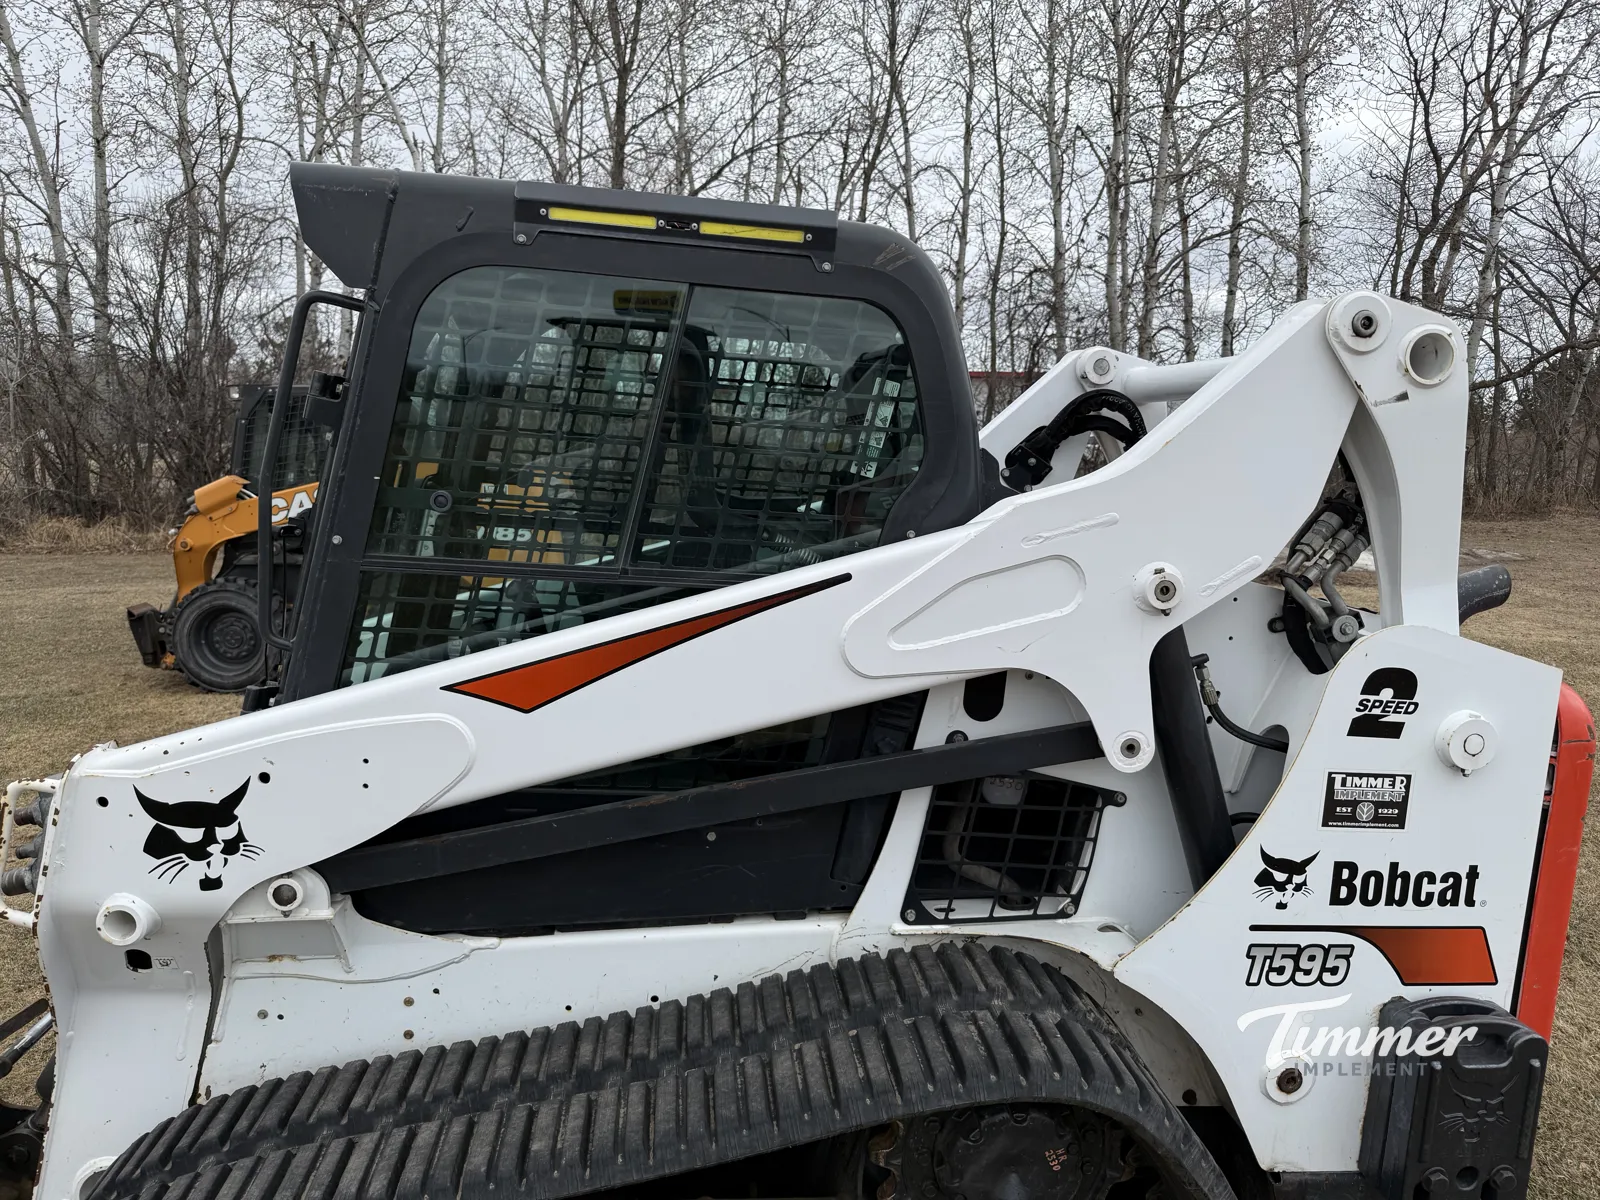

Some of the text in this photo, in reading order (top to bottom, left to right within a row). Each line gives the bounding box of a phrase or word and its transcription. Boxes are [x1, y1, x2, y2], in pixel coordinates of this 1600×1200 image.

[271, 488, 319, 523] CA
[1355, 698, 1419, 715] SPEED
[1331, 773, 1407, 792] TIMMER
[1334, 789, 1405, 802] IMPLEMENT
[1329, 860, 1480, 908] Bobcat
[1246, 943, 1355, 986] T595
